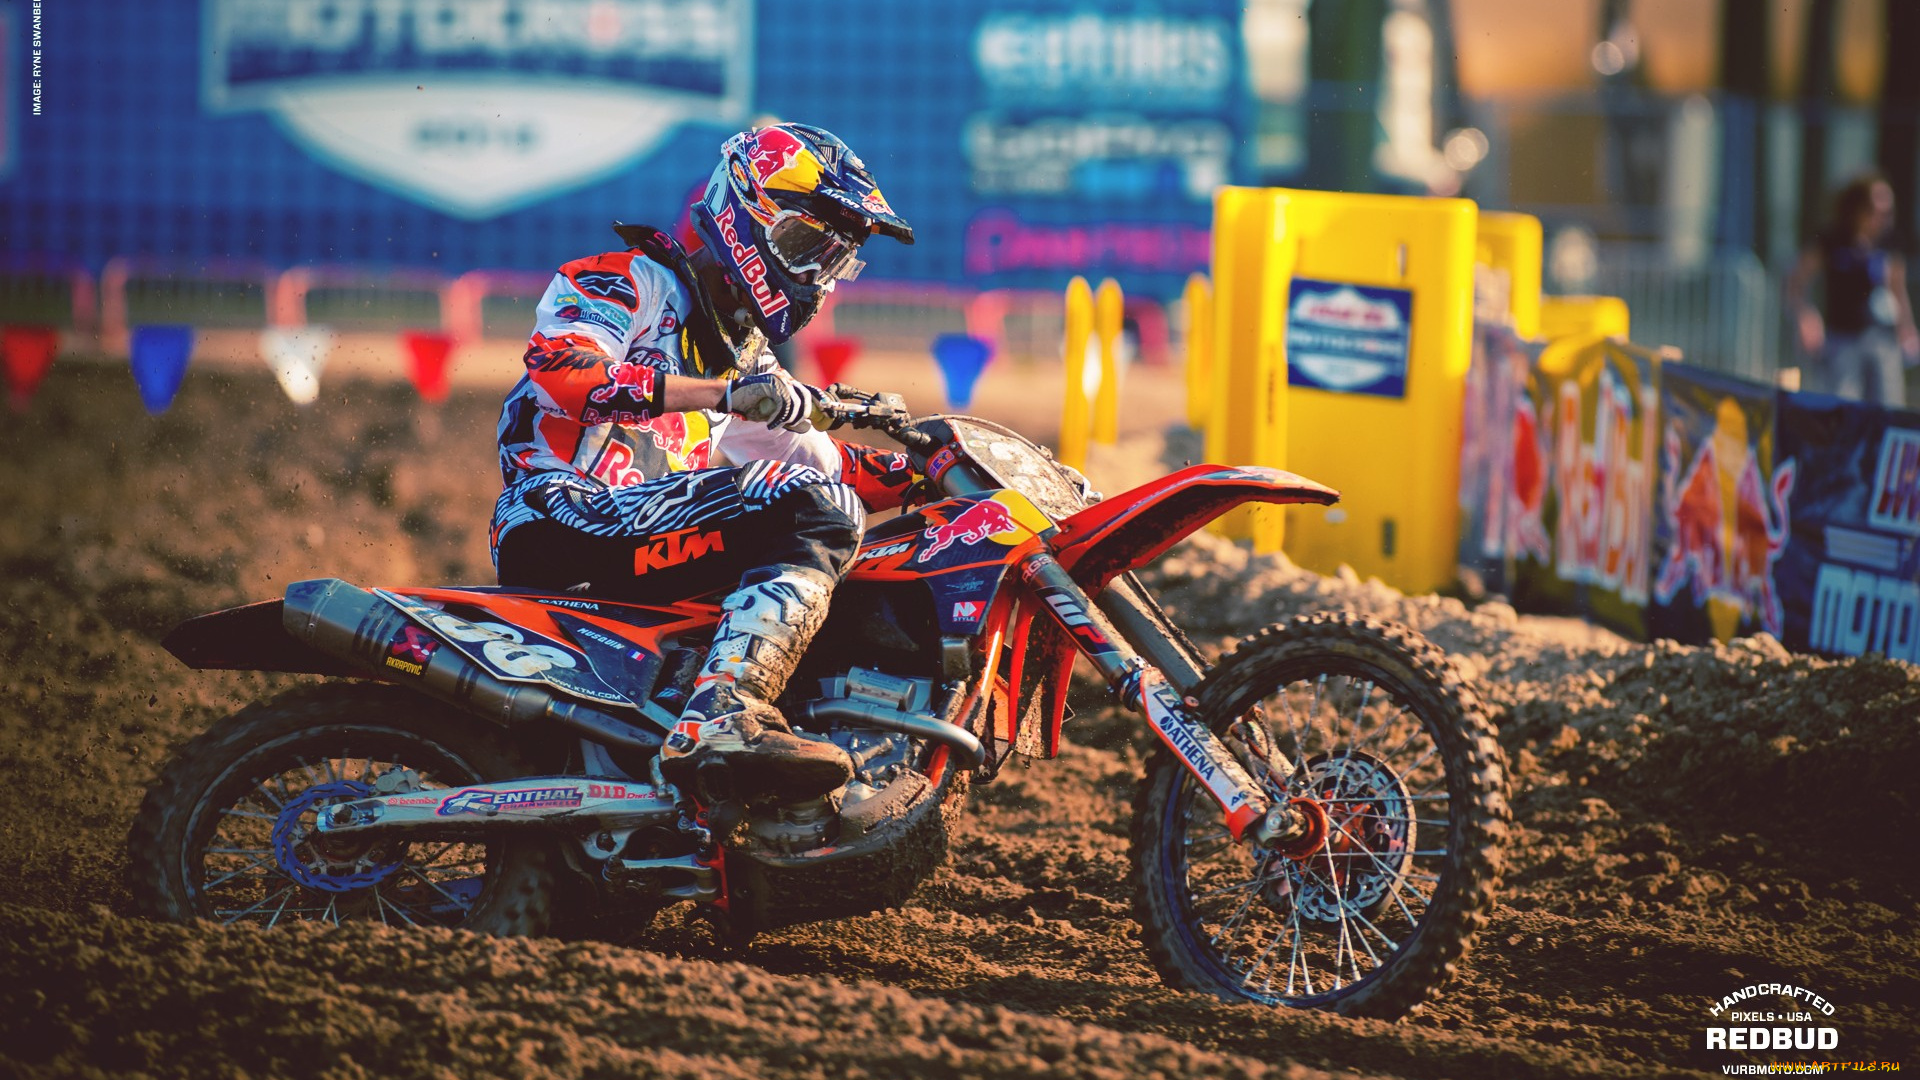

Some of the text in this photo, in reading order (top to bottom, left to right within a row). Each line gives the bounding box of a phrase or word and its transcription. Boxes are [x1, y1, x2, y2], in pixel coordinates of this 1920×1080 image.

[627, 350, 680, 376] Airoh
[593, 437, 645, 488] Re
[634, 526, 725, 577] KTM
[855, 542, 910, 561] KTM
[551, 599, 599, 611] ATHENA
[577, 627, 625, 651] MUSQUIN
[1167, 721, 1216, 781] ATHENA
[399, 796, 438, 805] brembo
